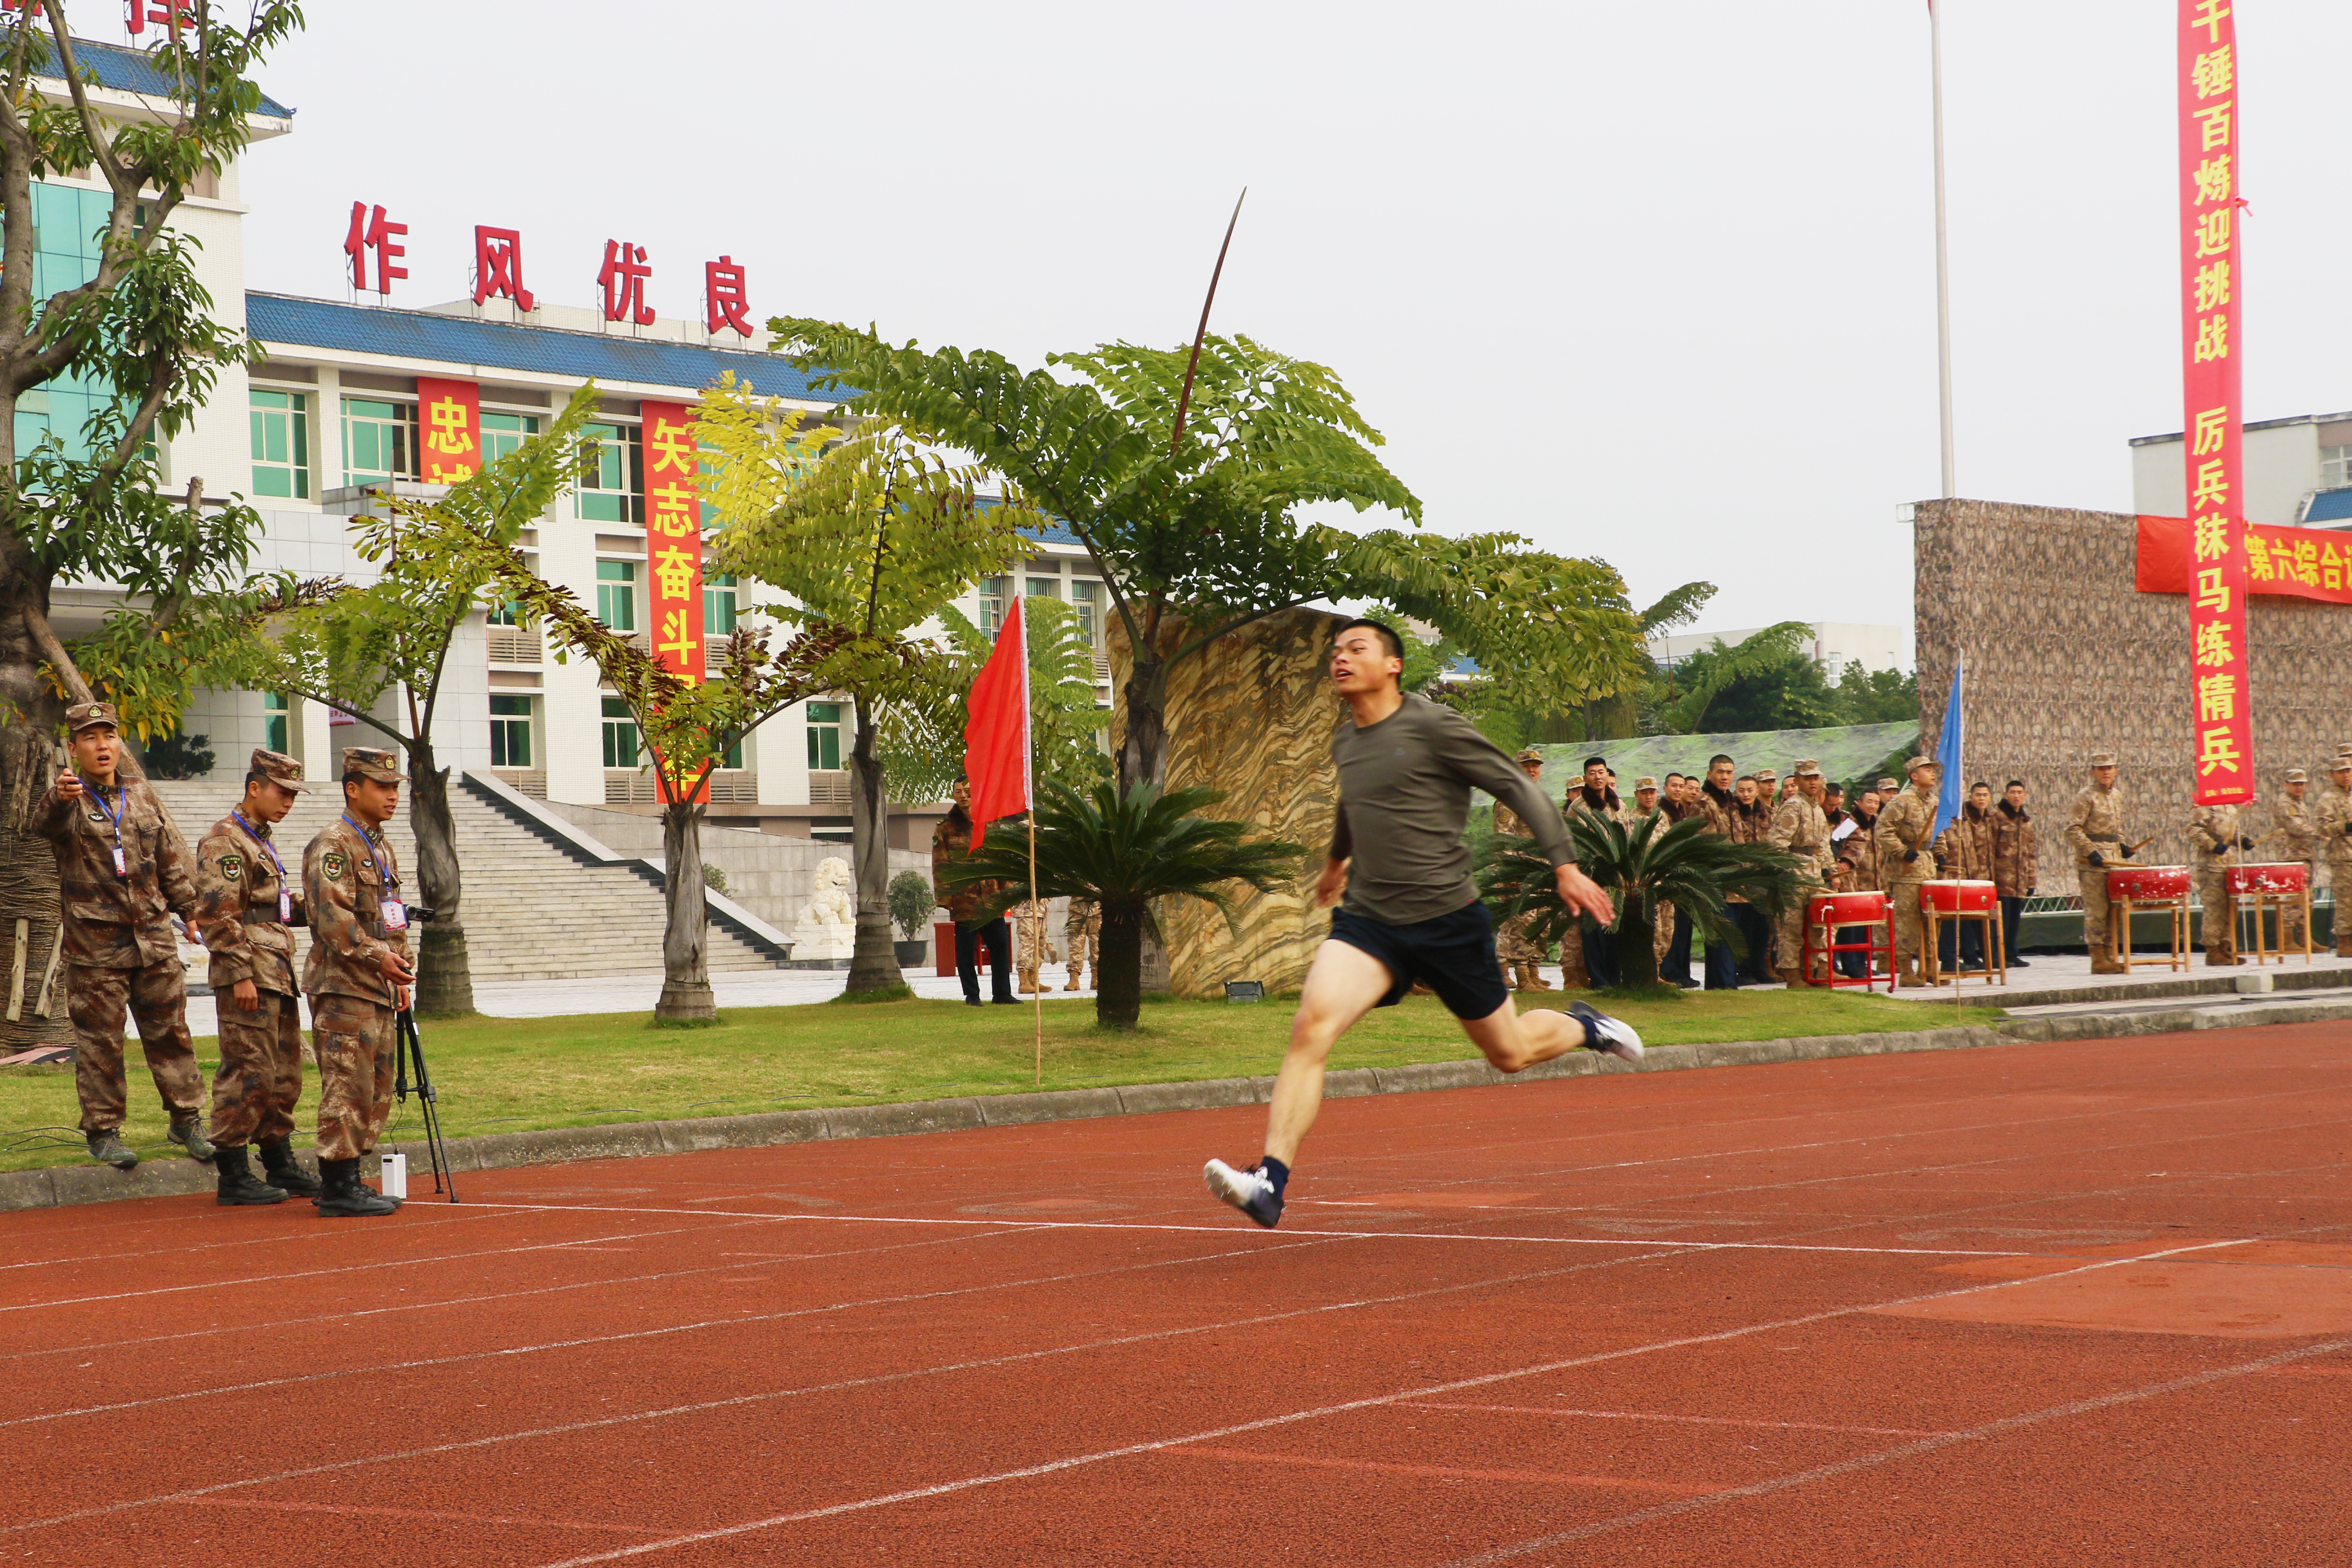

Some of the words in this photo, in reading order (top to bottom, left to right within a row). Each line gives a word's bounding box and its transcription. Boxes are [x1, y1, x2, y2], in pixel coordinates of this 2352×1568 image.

[344, 201, 752, 337] 作风优良
[2191, 0, 2232, 364] 千锤百炼迎挑战
[652, 417, 701, 792] 矢志奋斗
[2192, 406, 2240, 776] 厉兵秣马练精兵
[2243, 534, 2352, 590] 第六综合
